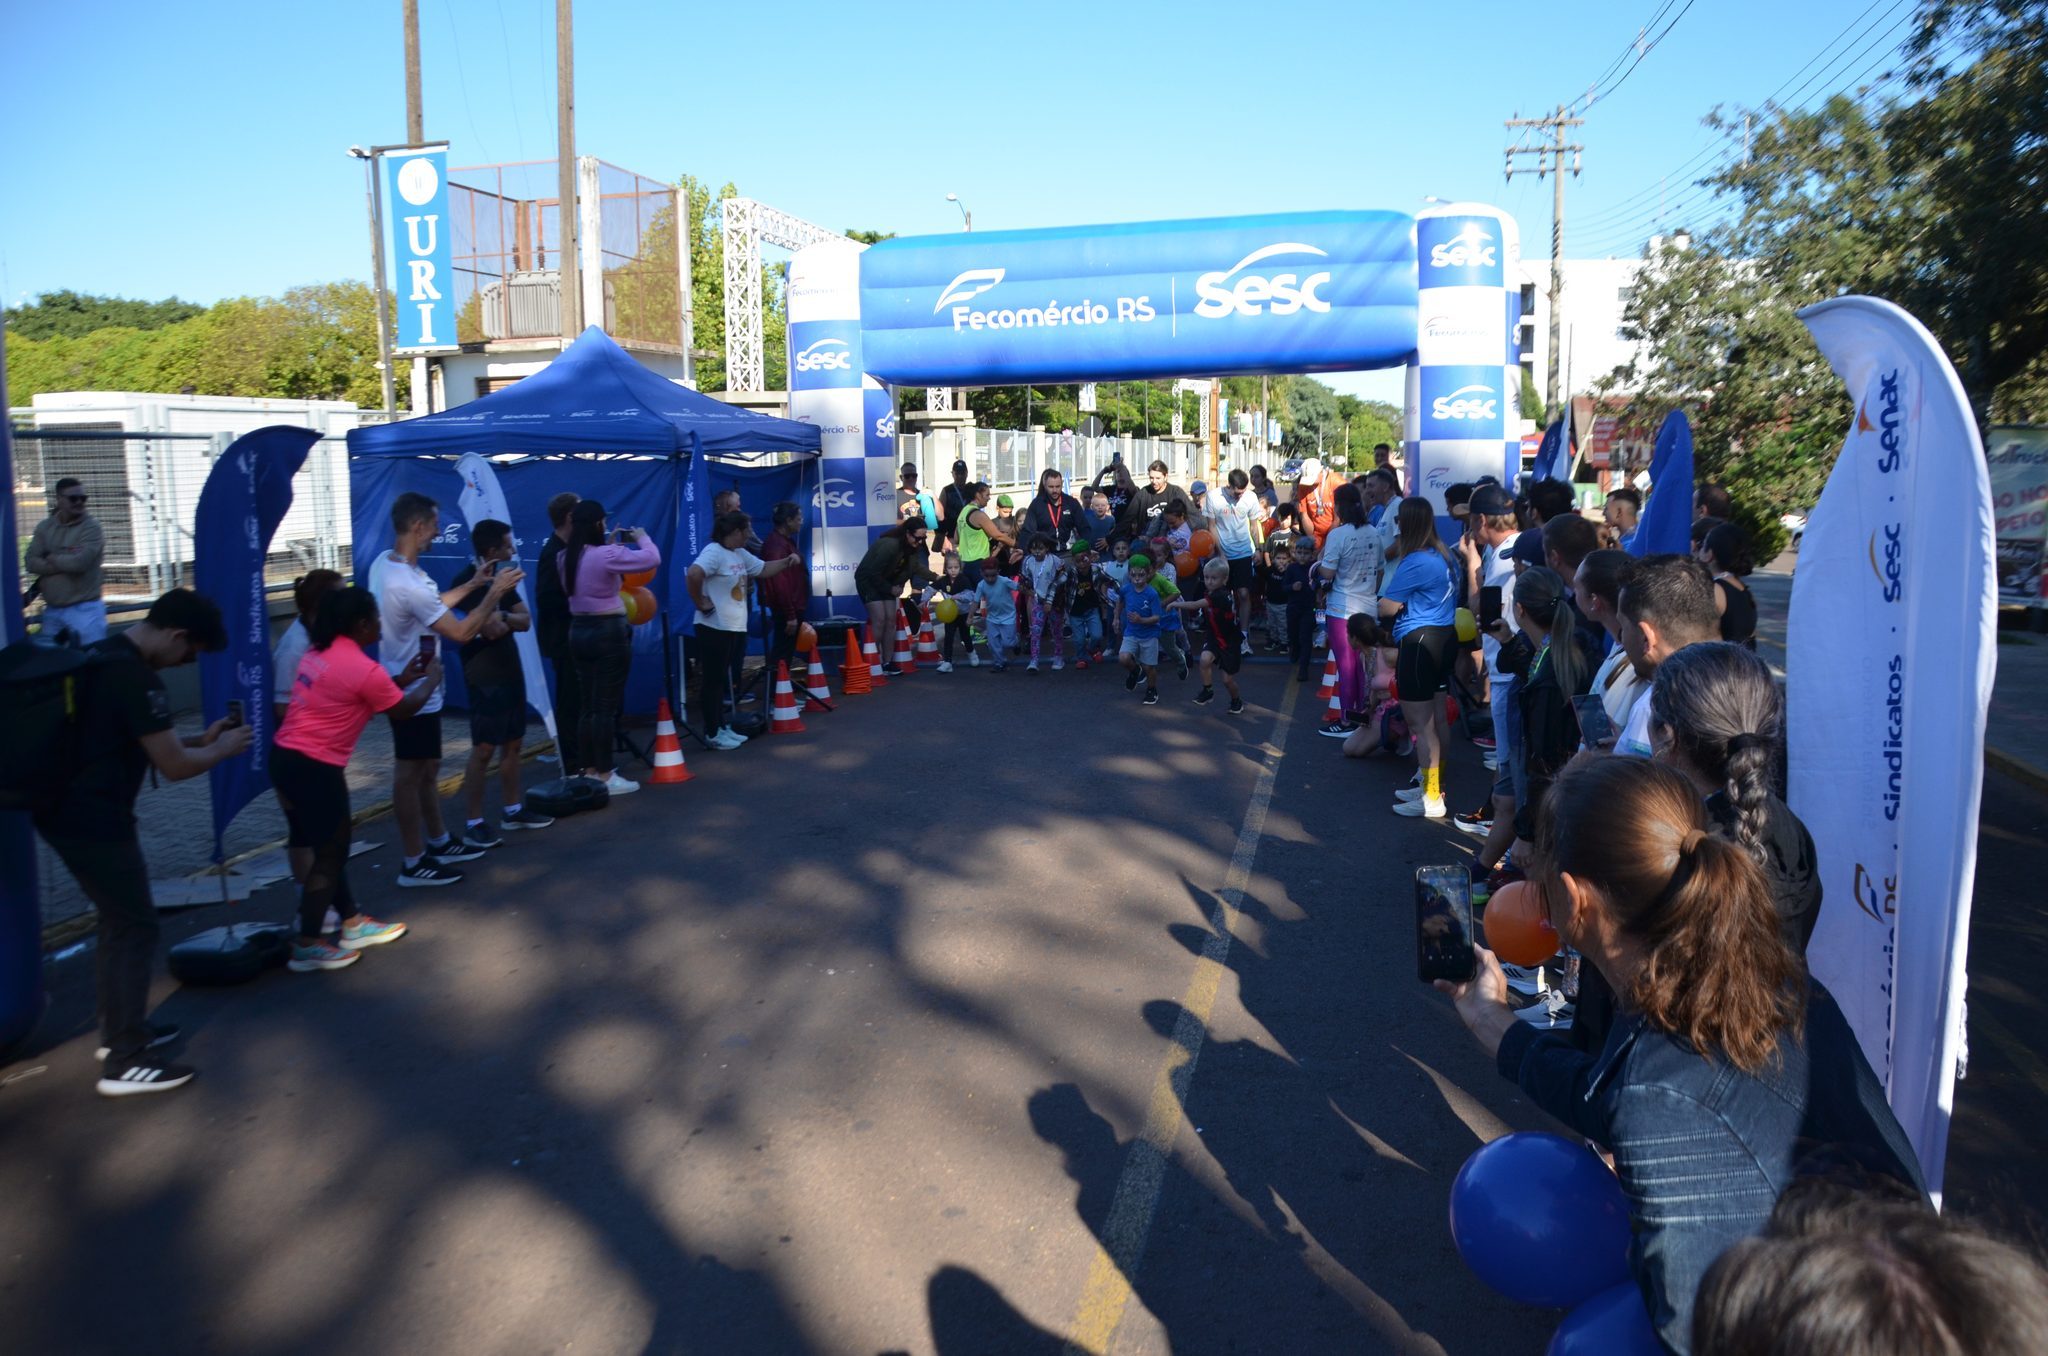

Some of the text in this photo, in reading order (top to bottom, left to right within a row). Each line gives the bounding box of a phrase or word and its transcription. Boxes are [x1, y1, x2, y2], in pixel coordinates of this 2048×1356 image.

[403, 214, 442, 344] URI
[953, 271, 1331, 331] Fecomércio RS Sesc
[796, 351, 852, 372] Sesc
[821, 424, 860, 434] ércio RS
[875, 418, 894, 438] Se
[1432, 397, 1497, 420] Sesc
[1877, 368, 1899, 474] Senac
[812, 490, 855, 508] esc
[1883, 522, 1901, 604] Sesc
[1883, 654, 1903, 822] Sindicatos
